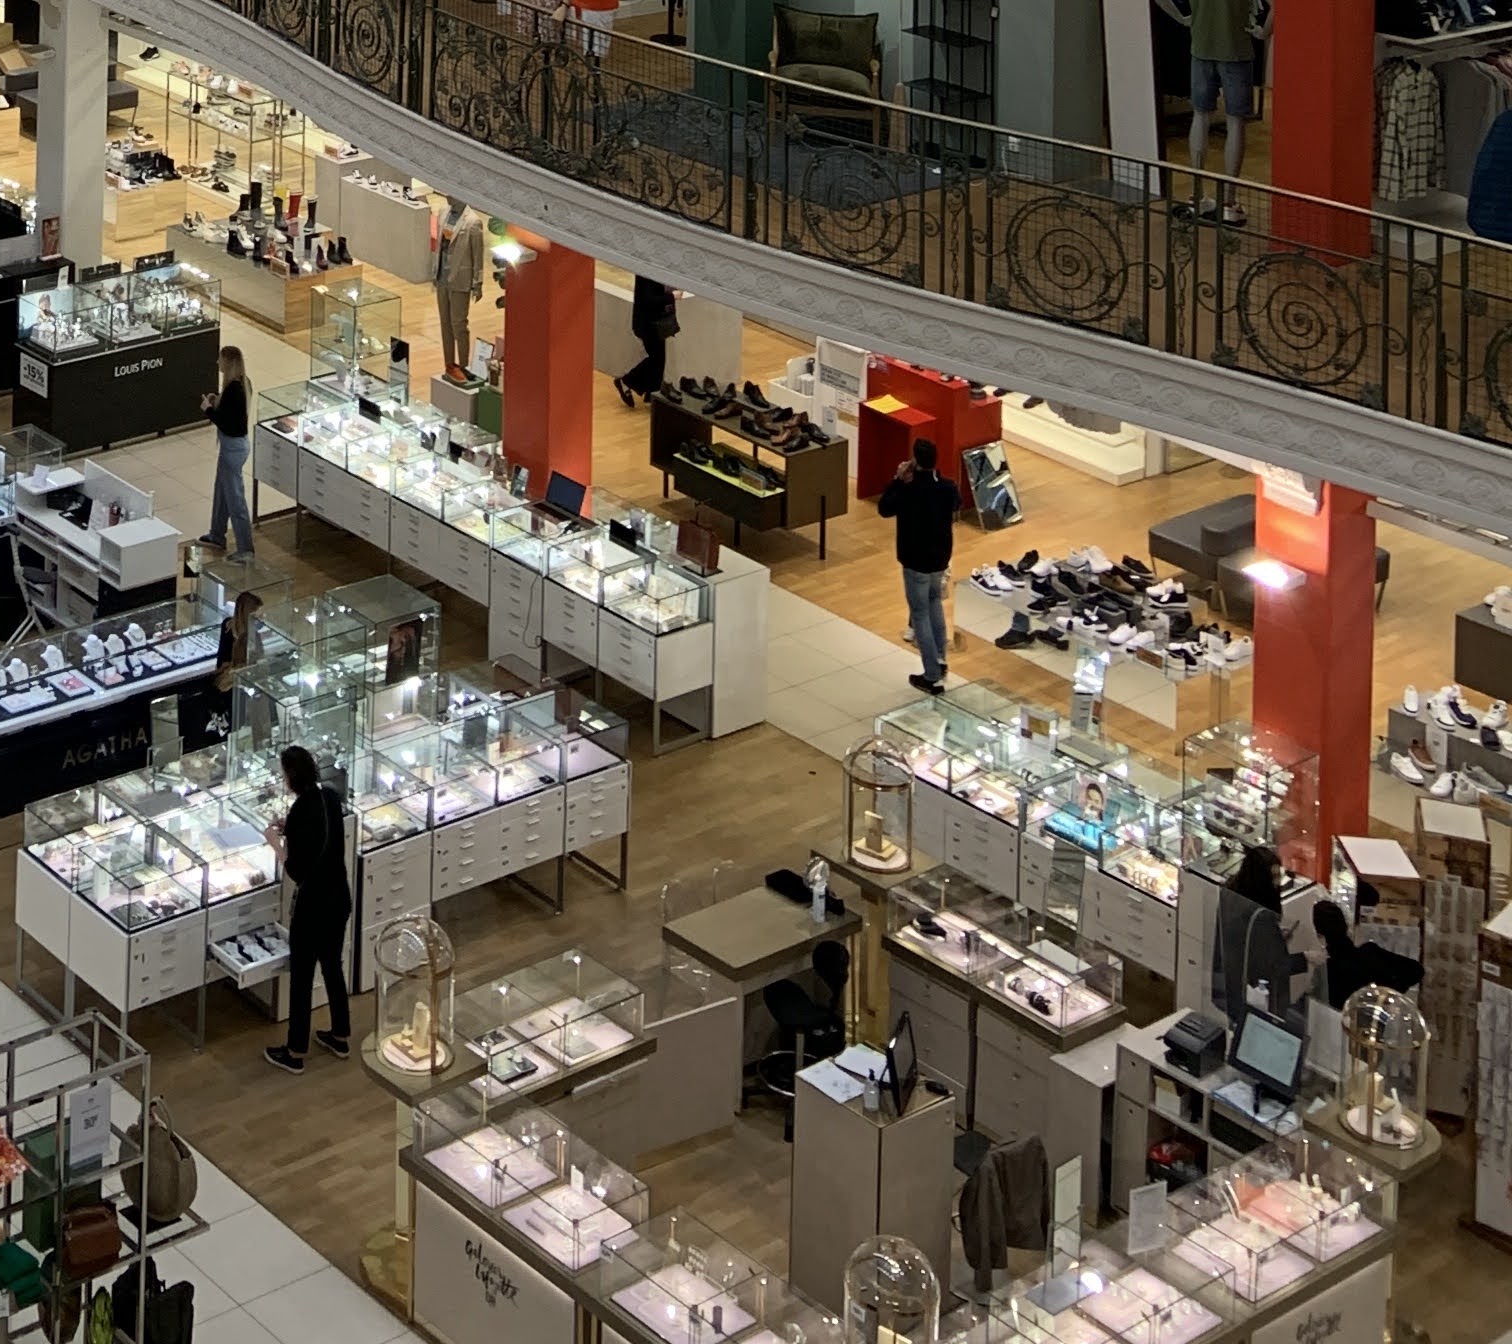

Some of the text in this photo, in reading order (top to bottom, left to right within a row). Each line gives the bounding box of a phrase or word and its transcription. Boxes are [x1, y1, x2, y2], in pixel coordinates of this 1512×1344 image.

[23, 363, 45, 383] -15%
[114, 357, 164, 378] LOUIS PION
[61, 727, 148, 769] AGATHA
